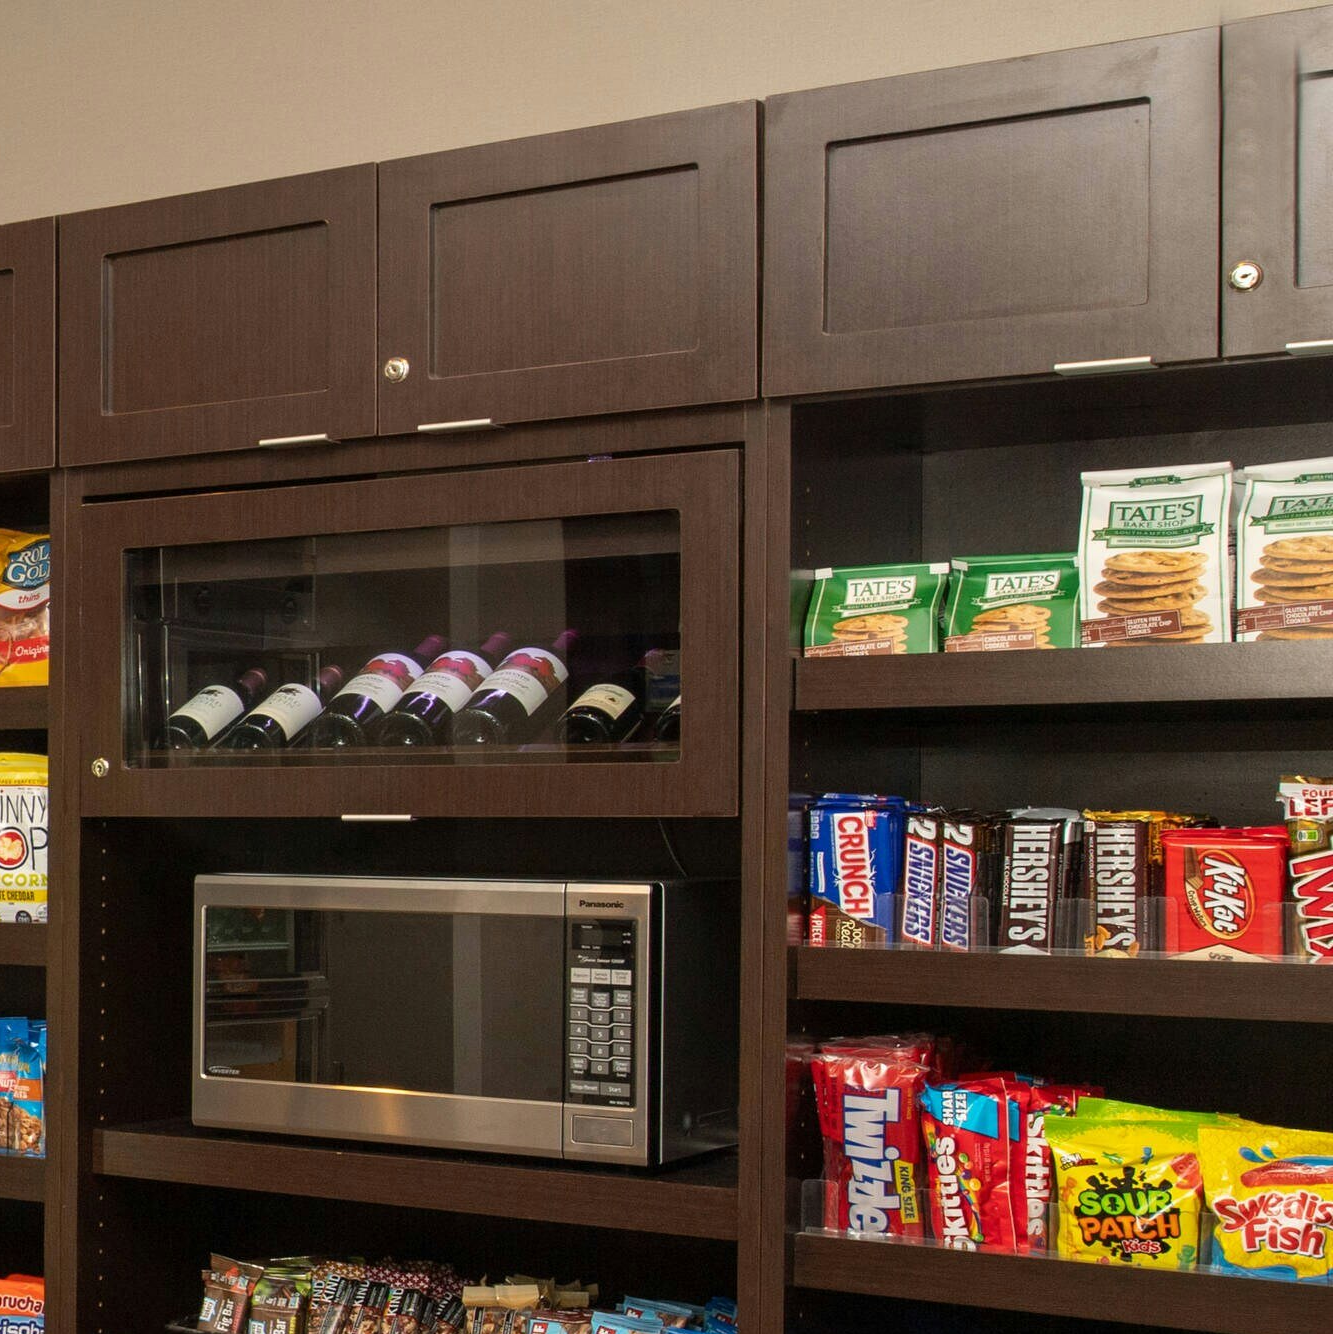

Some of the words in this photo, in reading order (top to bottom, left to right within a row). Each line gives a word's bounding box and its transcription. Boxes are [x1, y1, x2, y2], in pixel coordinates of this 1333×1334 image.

[1116, 500, 1196, 523] TATE'S
[1123, 521, 1154, 529] BAKE
[1156, 518, 1188, 528] SHOP
[849, 579, 912, 597] TATE'S
[990, 573, 1055, 591] TATE'S
[18, 592, 41, 604] thins
[854, 595, 878, 603] BAKE
[880, 593, 905, 602] SHOP
[1285, 606, 1305, 615] GLUTEN
[1306, 605, 1323, 613] FREE
[1285, 611, 1318, 619] CHOCOLATE
[1127, 617, 1147, 626] GLUTEN
[1148, 616, 1162, 624] FREE
[1127, 622, 1159, 631] CHOCOLATE
[1285, 617, 1311, 626] COOKIES
[983, 635, 1016, 644] CHOCOLATE
[1017, 633, 1033, 641] CHIP
[1127, 628, 1152, 636] COOKIES
[845, 643, 874, 652] CHOCOLATE
[875, 641, 891, 649] CHIP
[983, 641, 1010, 650] COOKIES
[908, 817, 937, 840] 2
[944, 823, 974, 845] 2
[837, 815, 870, 917] CRUNCH
[902, 841, 935, 944] SNICKERS
[1007, 825, 1051, 942] HERSHEY'S
[1096, 828, 1137, 947] HERSHEY'S
[6, 890, 35, 901] CHEDDAR
[579, 899, 625, 909] Panasonic
[942, 848, 972, 950] SNICKERS
[955, 1092, 968, 1121] SIZE
[899, 1165, 911, 1192] KING
[902, 1194, 915, 1219] SIZE
[1078, 1190, 1173, 1217] SOUR
[1213, 1190, 1333, 1231] Swedis
[1079, 1212, 1181, 1243] PATCH
[1244, 1216, 1326, 1257] Fish
[1122, 1238, 1162, 1254] Kids
[353, 1279, 370, 1306] KIND
[386, 1288, 404, 1317] KIND
